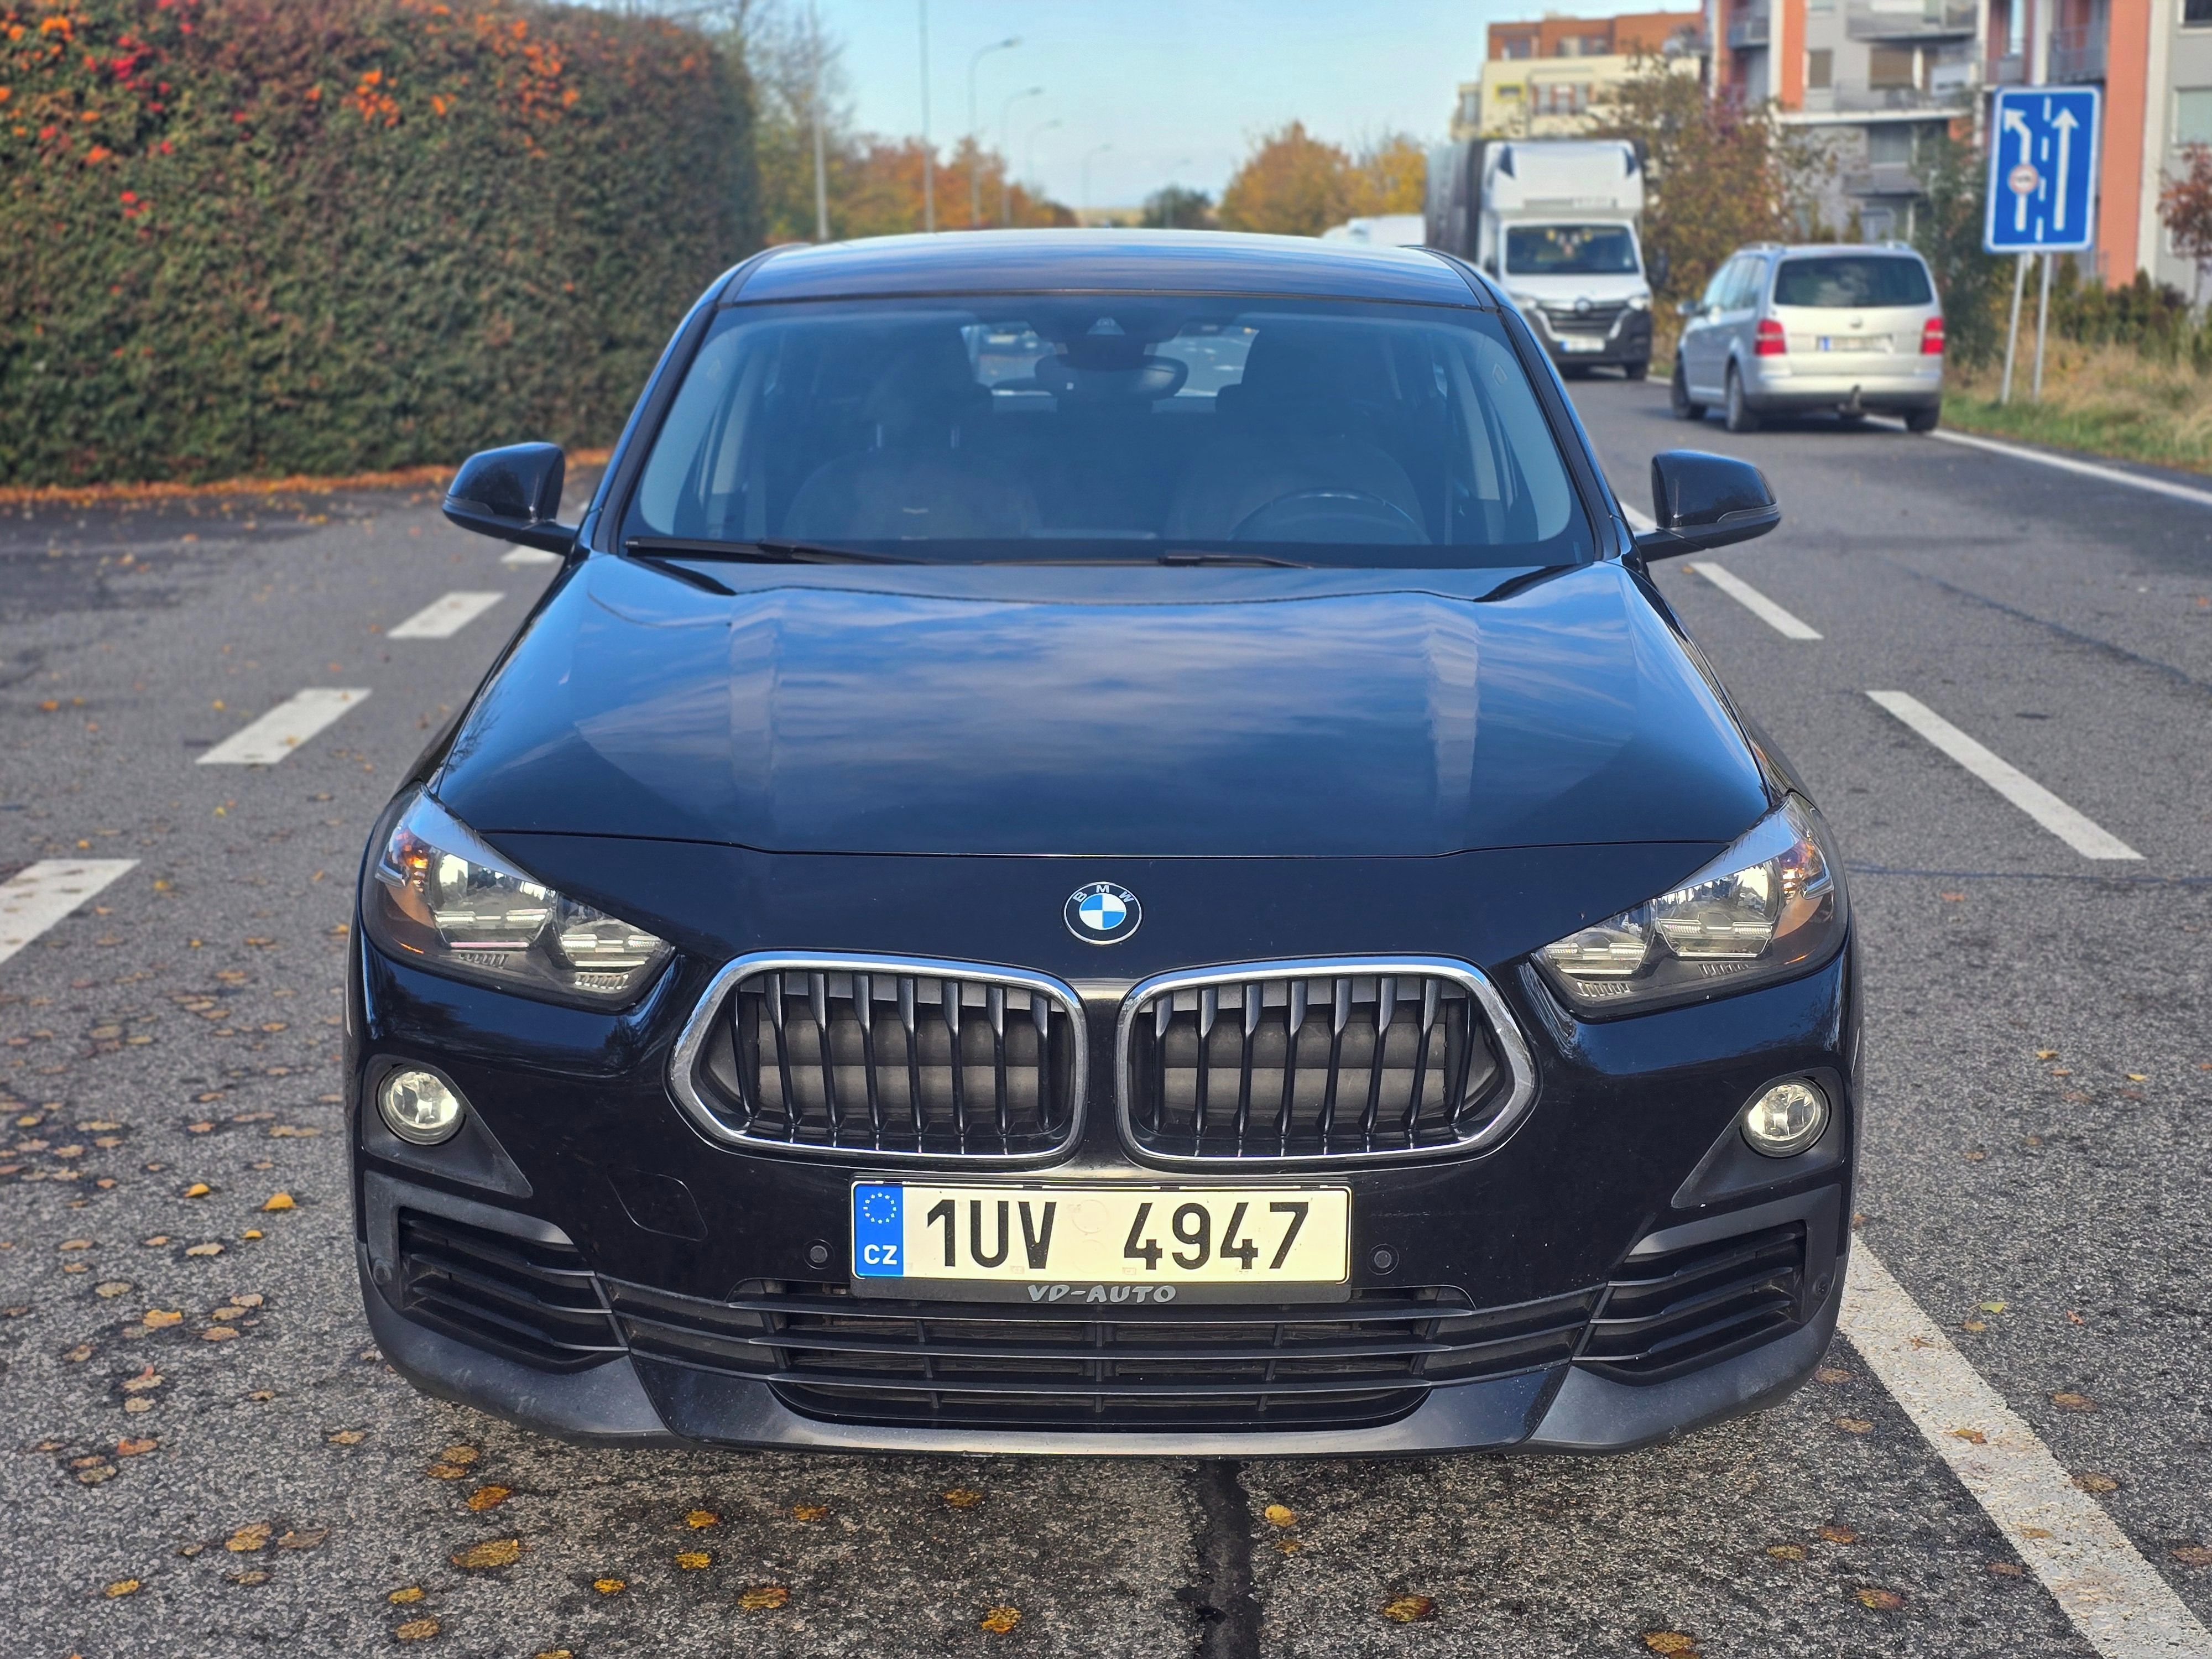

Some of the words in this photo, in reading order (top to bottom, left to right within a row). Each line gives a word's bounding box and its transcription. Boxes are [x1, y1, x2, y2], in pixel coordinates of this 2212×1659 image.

[1072, 885, 1134, 902] BMW
[927, 1199, 1057, 1269] 1UV
[1124, 1202, 1308, 1270] 4947
[864, 1244, 898, 1265] CZ
[1027, 1285, 1176, 1303] VD-AUTO
